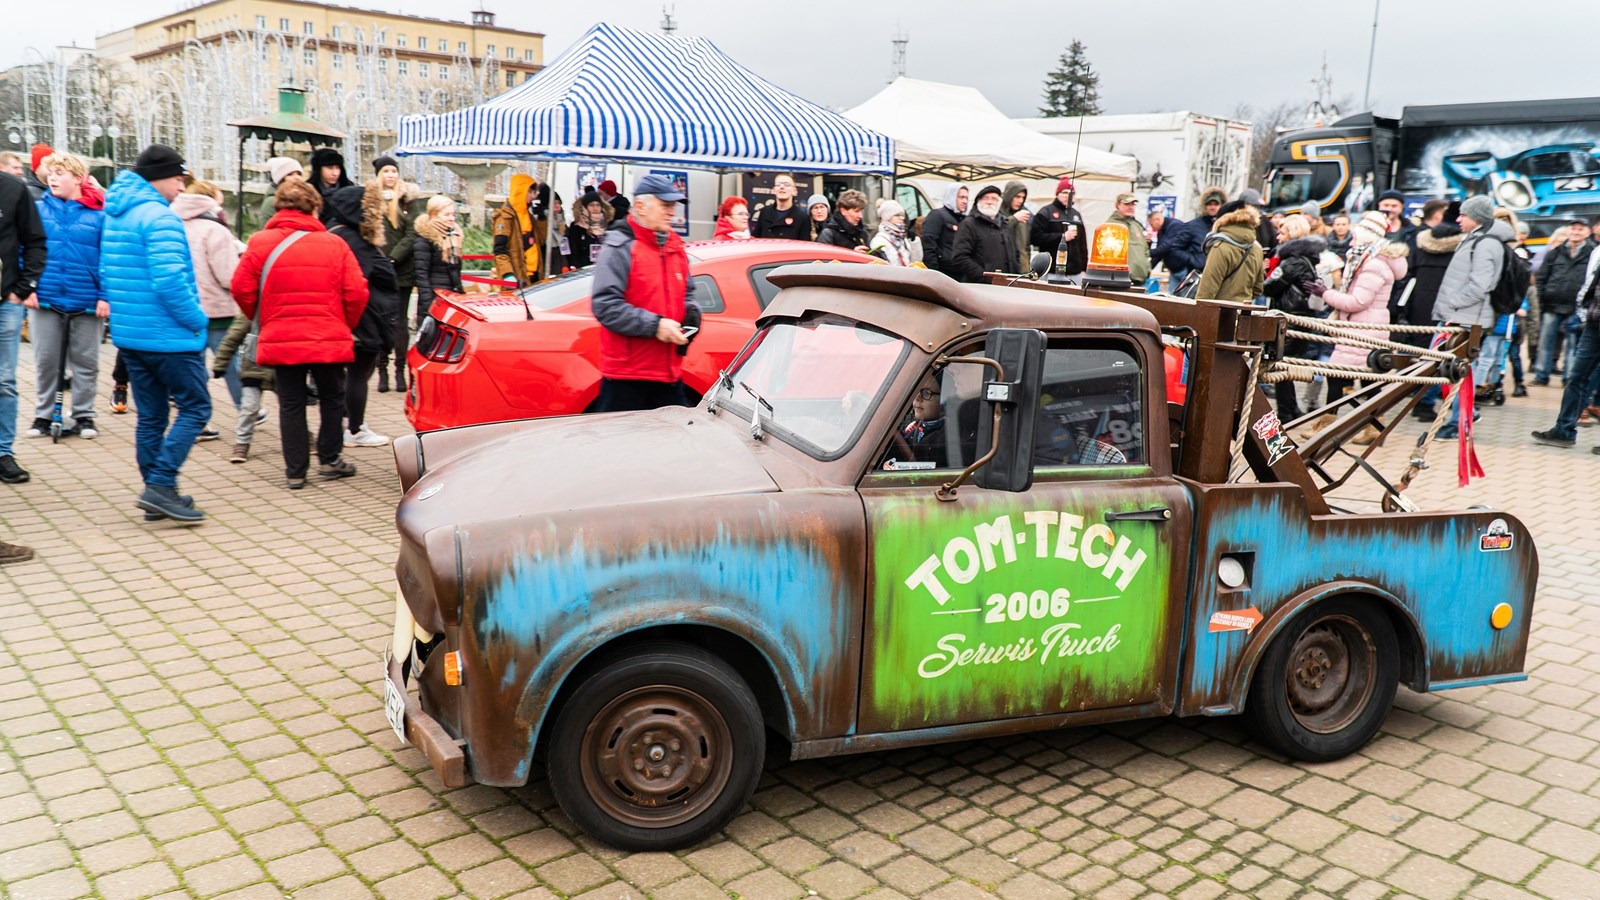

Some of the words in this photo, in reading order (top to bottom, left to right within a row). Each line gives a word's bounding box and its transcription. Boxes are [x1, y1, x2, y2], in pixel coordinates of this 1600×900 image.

[905, 510, 1147, 606] TOM-TECH
[985, 588, 1070, 623] 2006
[917, 633, 1037, 678] Serwis
[1040, 622, 1121, 665] Truck
